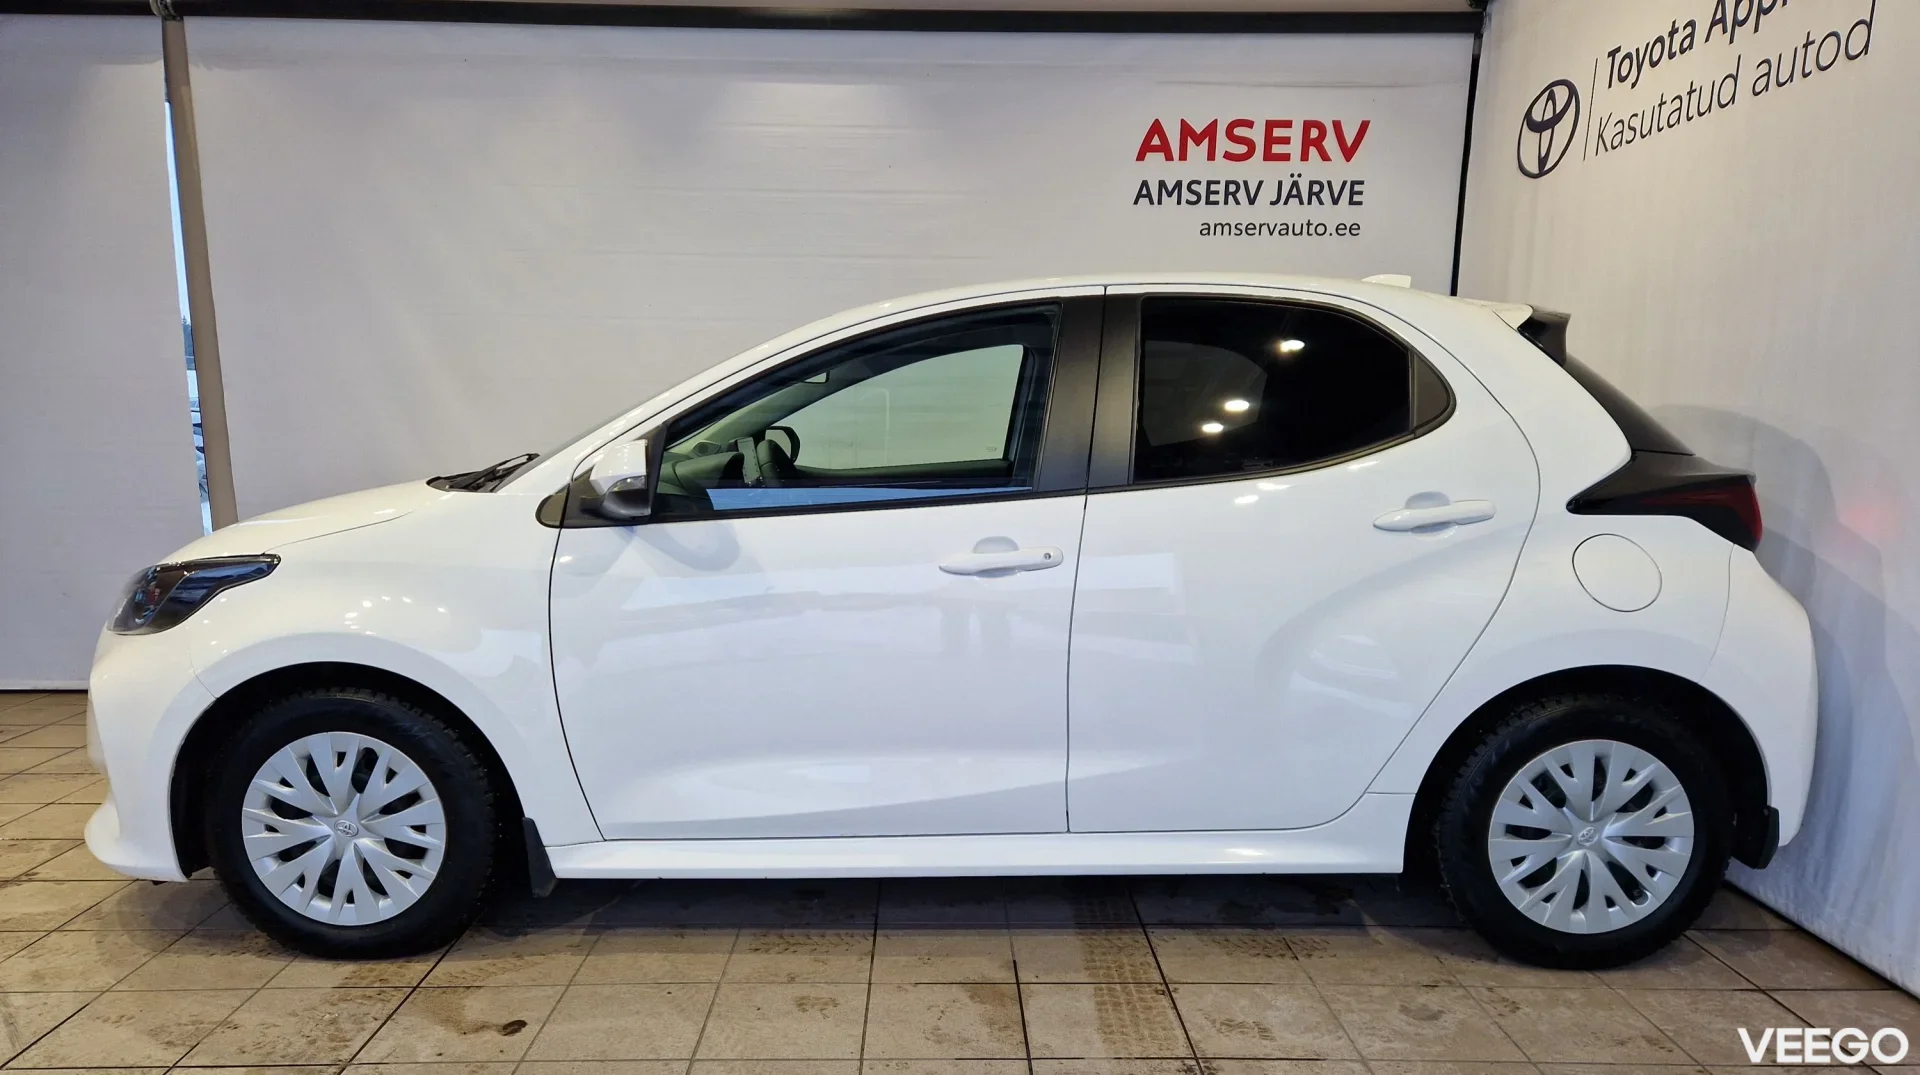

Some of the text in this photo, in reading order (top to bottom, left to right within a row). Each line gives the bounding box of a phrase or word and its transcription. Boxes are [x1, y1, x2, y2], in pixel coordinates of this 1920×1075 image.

[1607, 0, 1788, 89] Toyota App
[1595, 0, 1876, 156] Kasutatud autod
[1135, 118, 1371, 162] AMSERV
[1133, 172, 1365, 206] AMSERV JÄRVE
[1199, 219, 1361, 237] amservauto.ee
